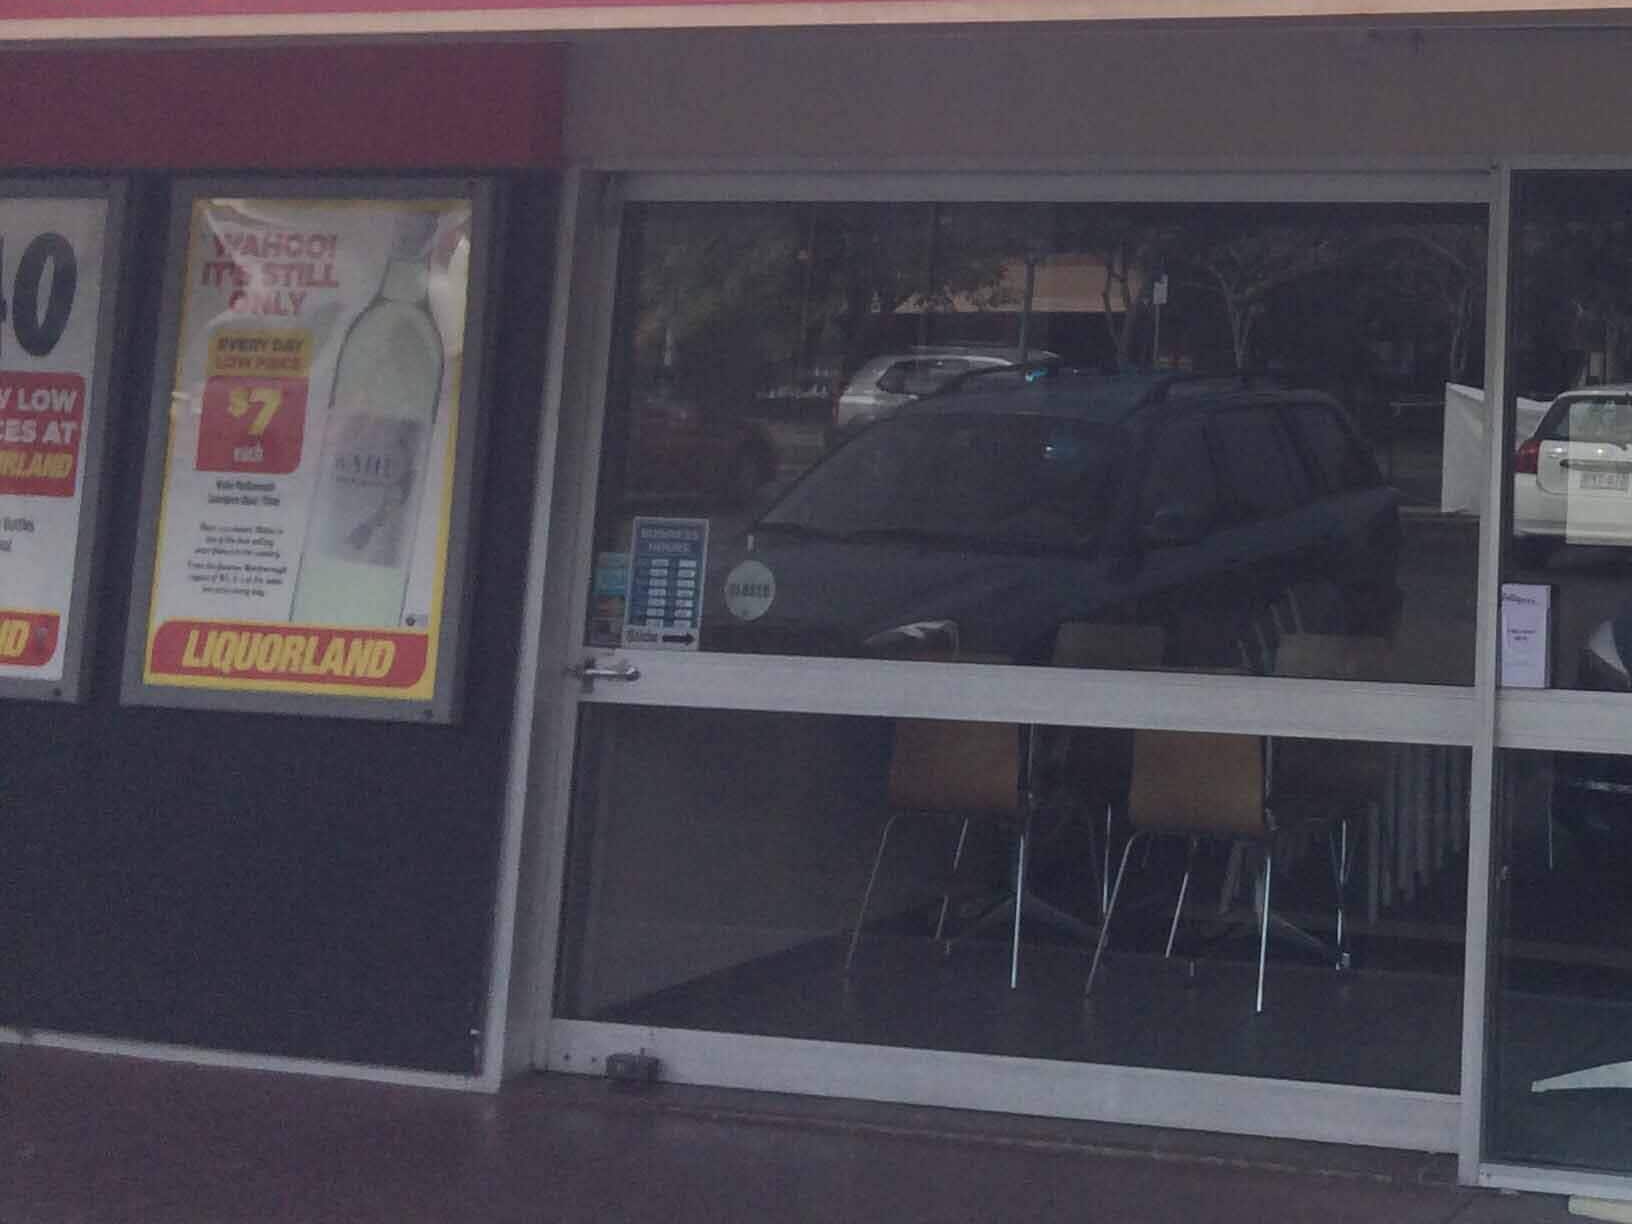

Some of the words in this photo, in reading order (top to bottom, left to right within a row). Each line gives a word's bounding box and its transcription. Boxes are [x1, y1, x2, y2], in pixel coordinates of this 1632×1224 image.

[17, 387, 79, 414] LOW
[228, 387, 283, 436] $7
[42, 421, 78, 445] AT
[181, 629, 396, 679] LIQUORLAND
